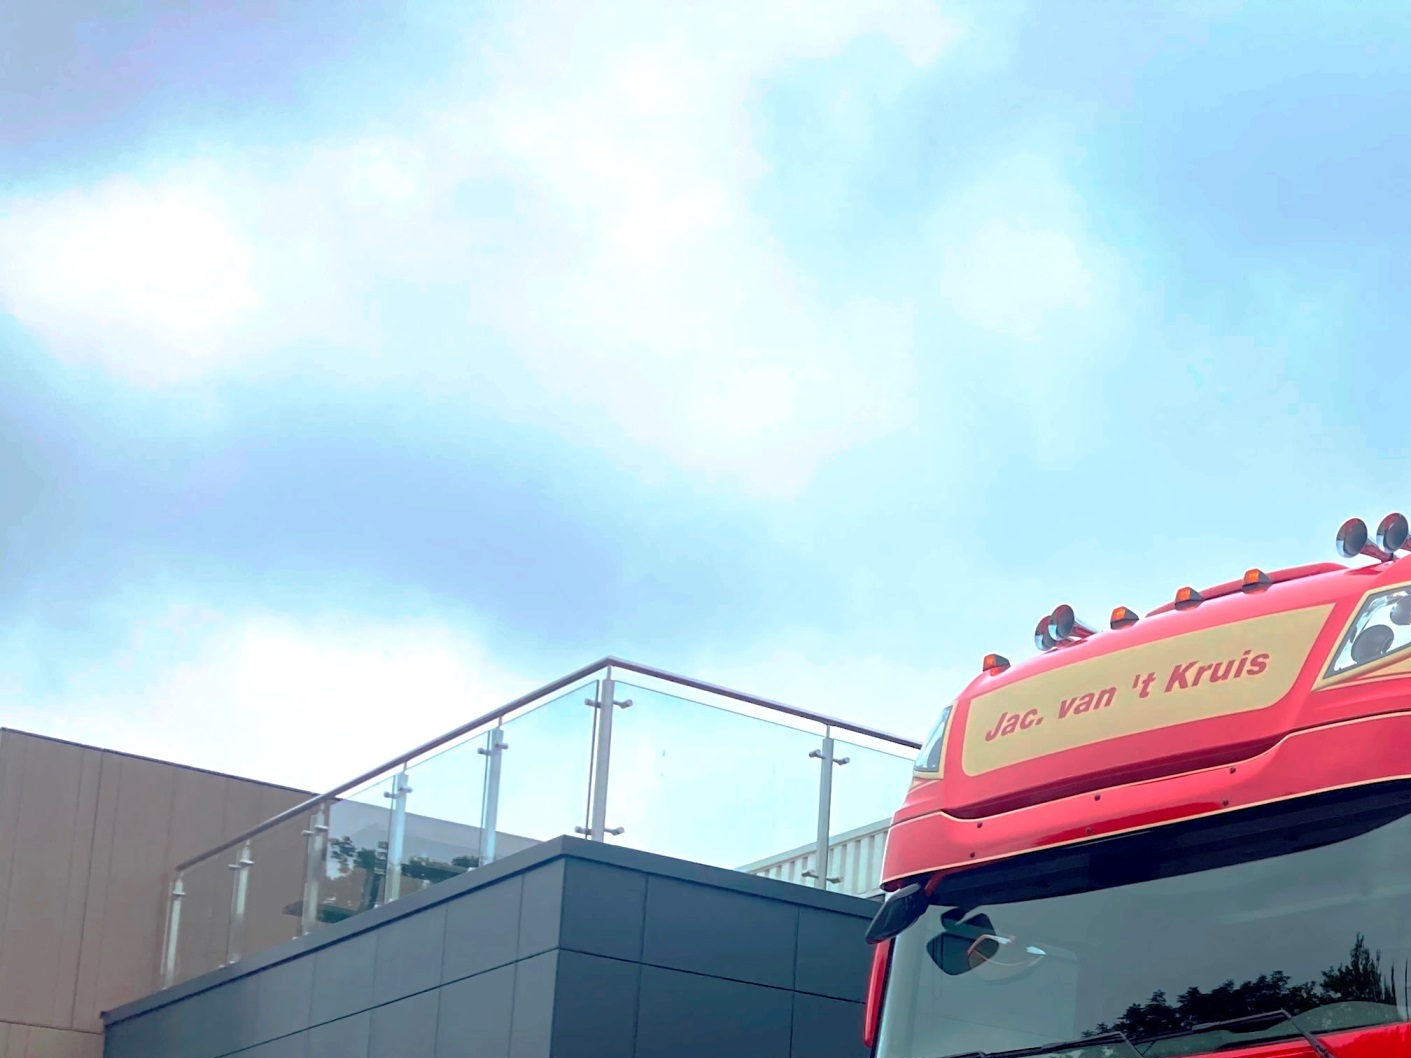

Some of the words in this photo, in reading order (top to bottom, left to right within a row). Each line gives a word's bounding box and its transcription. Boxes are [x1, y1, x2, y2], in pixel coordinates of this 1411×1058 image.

[985, 708, 1044, 742] Jac.
[1058, 685, 1117, 718] van
[1132, 672, 1156, 698] 't
[1164, 649, 1270, 694] Kruis
